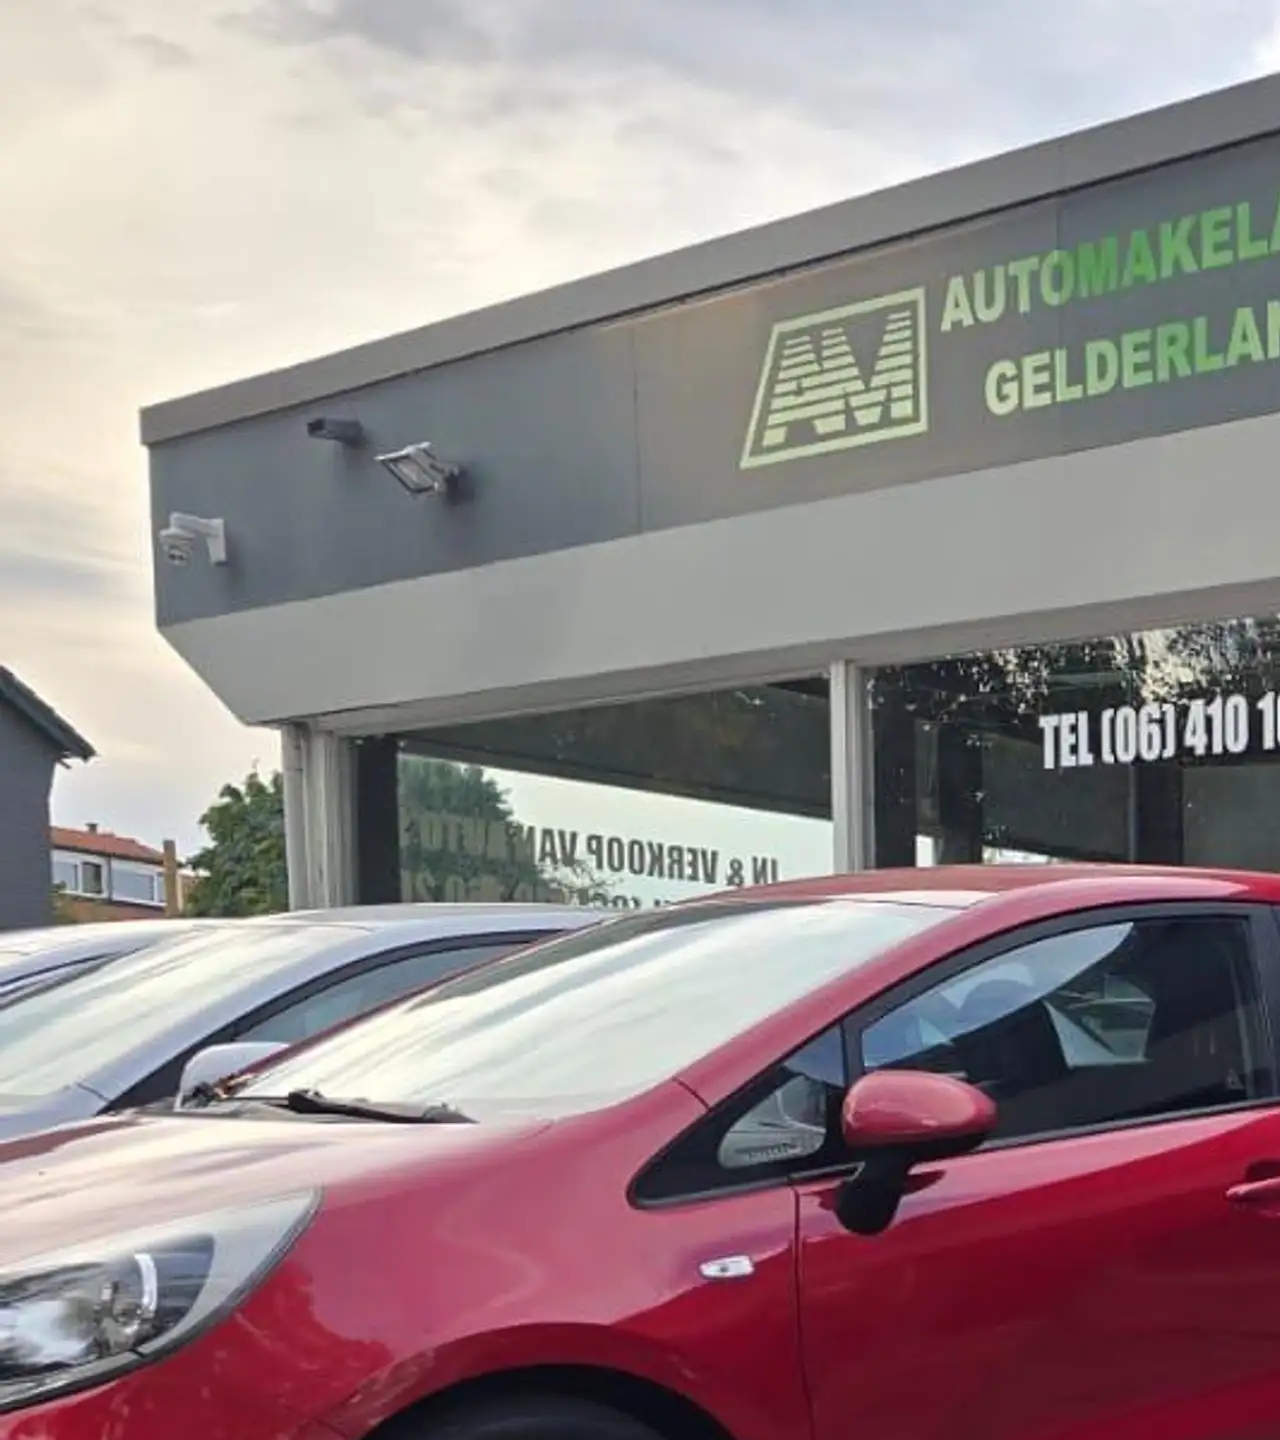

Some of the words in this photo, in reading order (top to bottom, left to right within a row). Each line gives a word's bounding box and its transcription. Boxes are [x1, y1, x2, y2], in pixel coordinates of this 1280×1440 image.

[1039, 710, 1094, 769] TEL
[1101, 705, 1176, 763] (06)
[1183, 694, 1249, 756] 410
